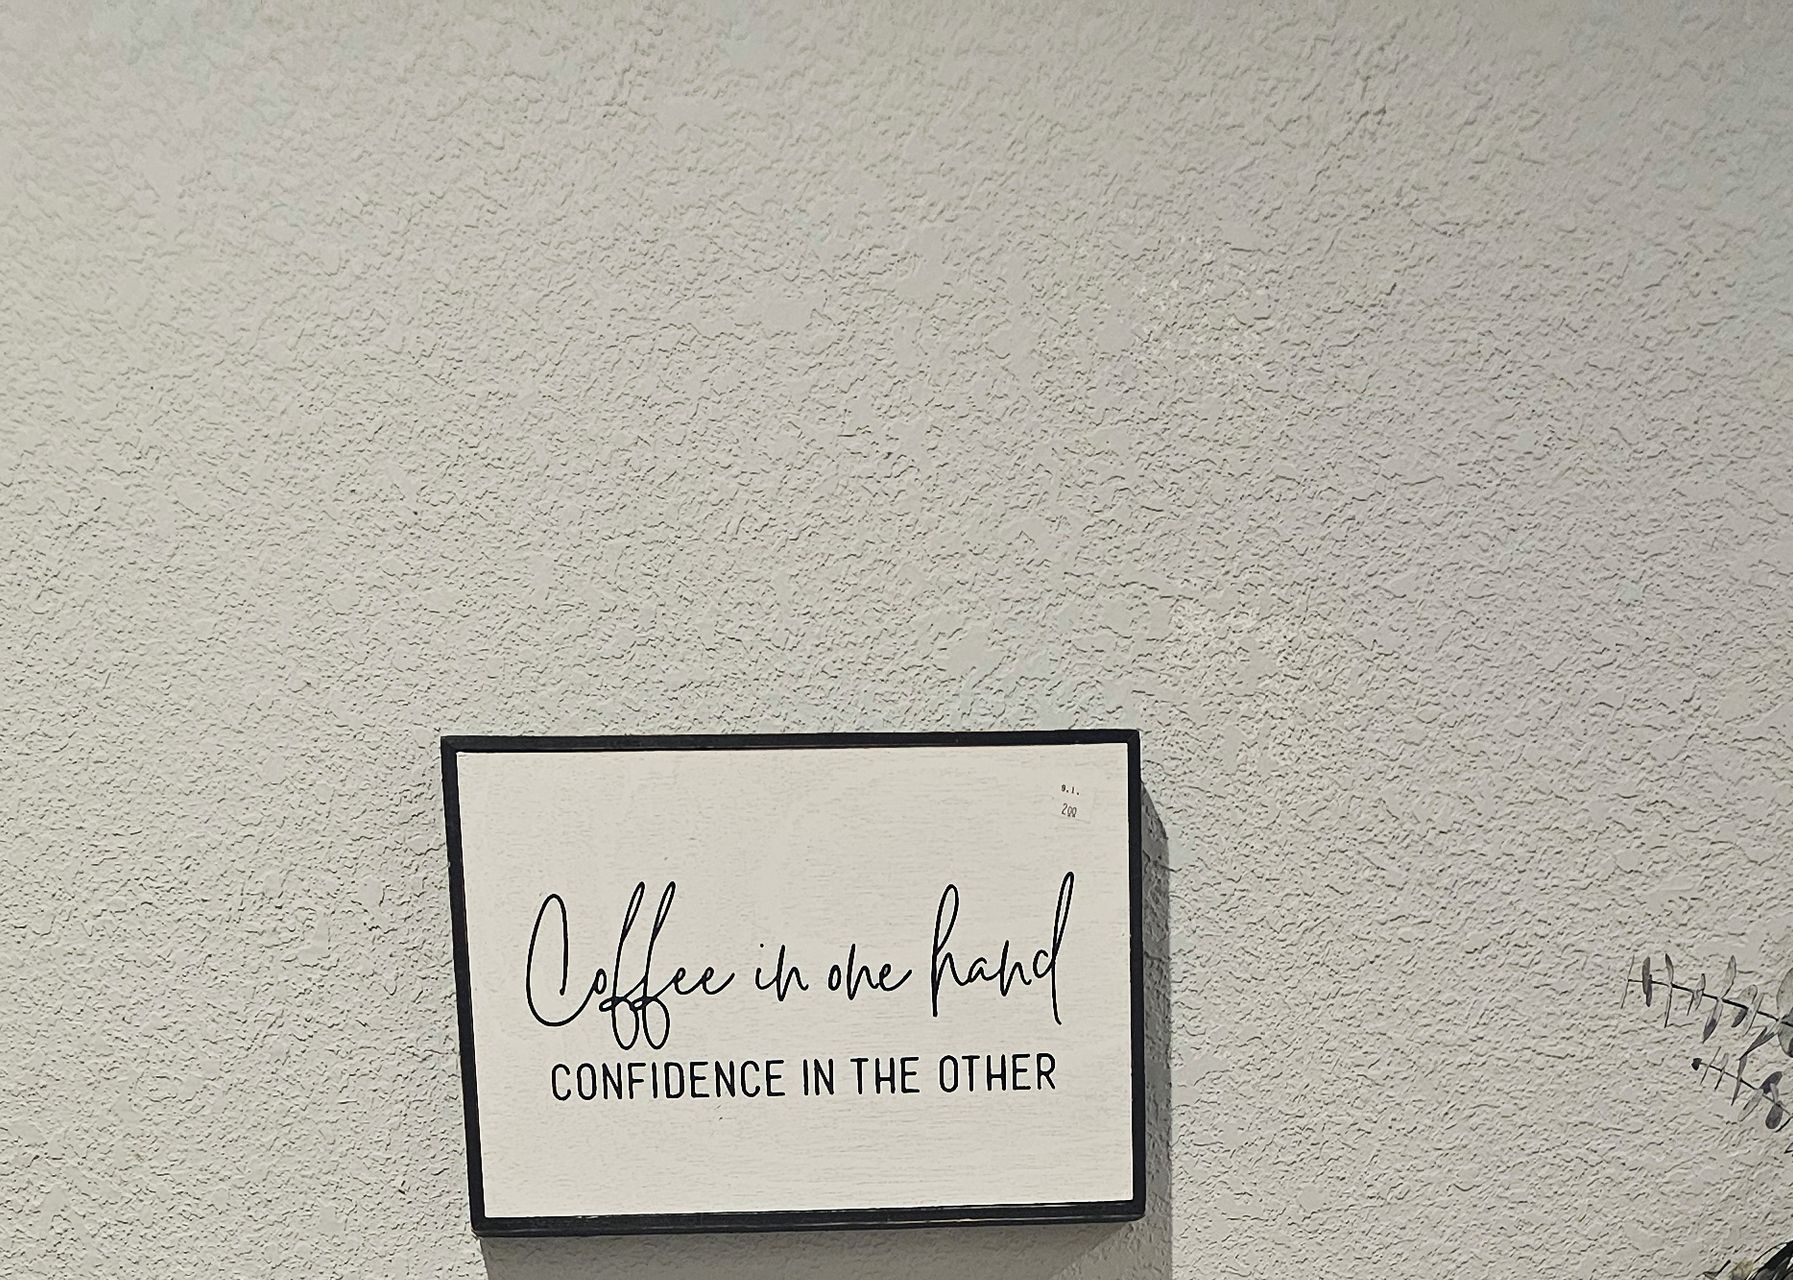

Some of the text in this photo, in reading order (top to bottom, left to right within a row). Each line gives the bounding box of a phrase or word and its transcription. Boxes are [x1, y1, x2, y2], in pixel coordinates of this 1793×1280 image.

[526, 872, 1075, 1050] Coffee in one hand
[551, 1052, 1057, 1101] CONFIDENCE IN THE OTHER
